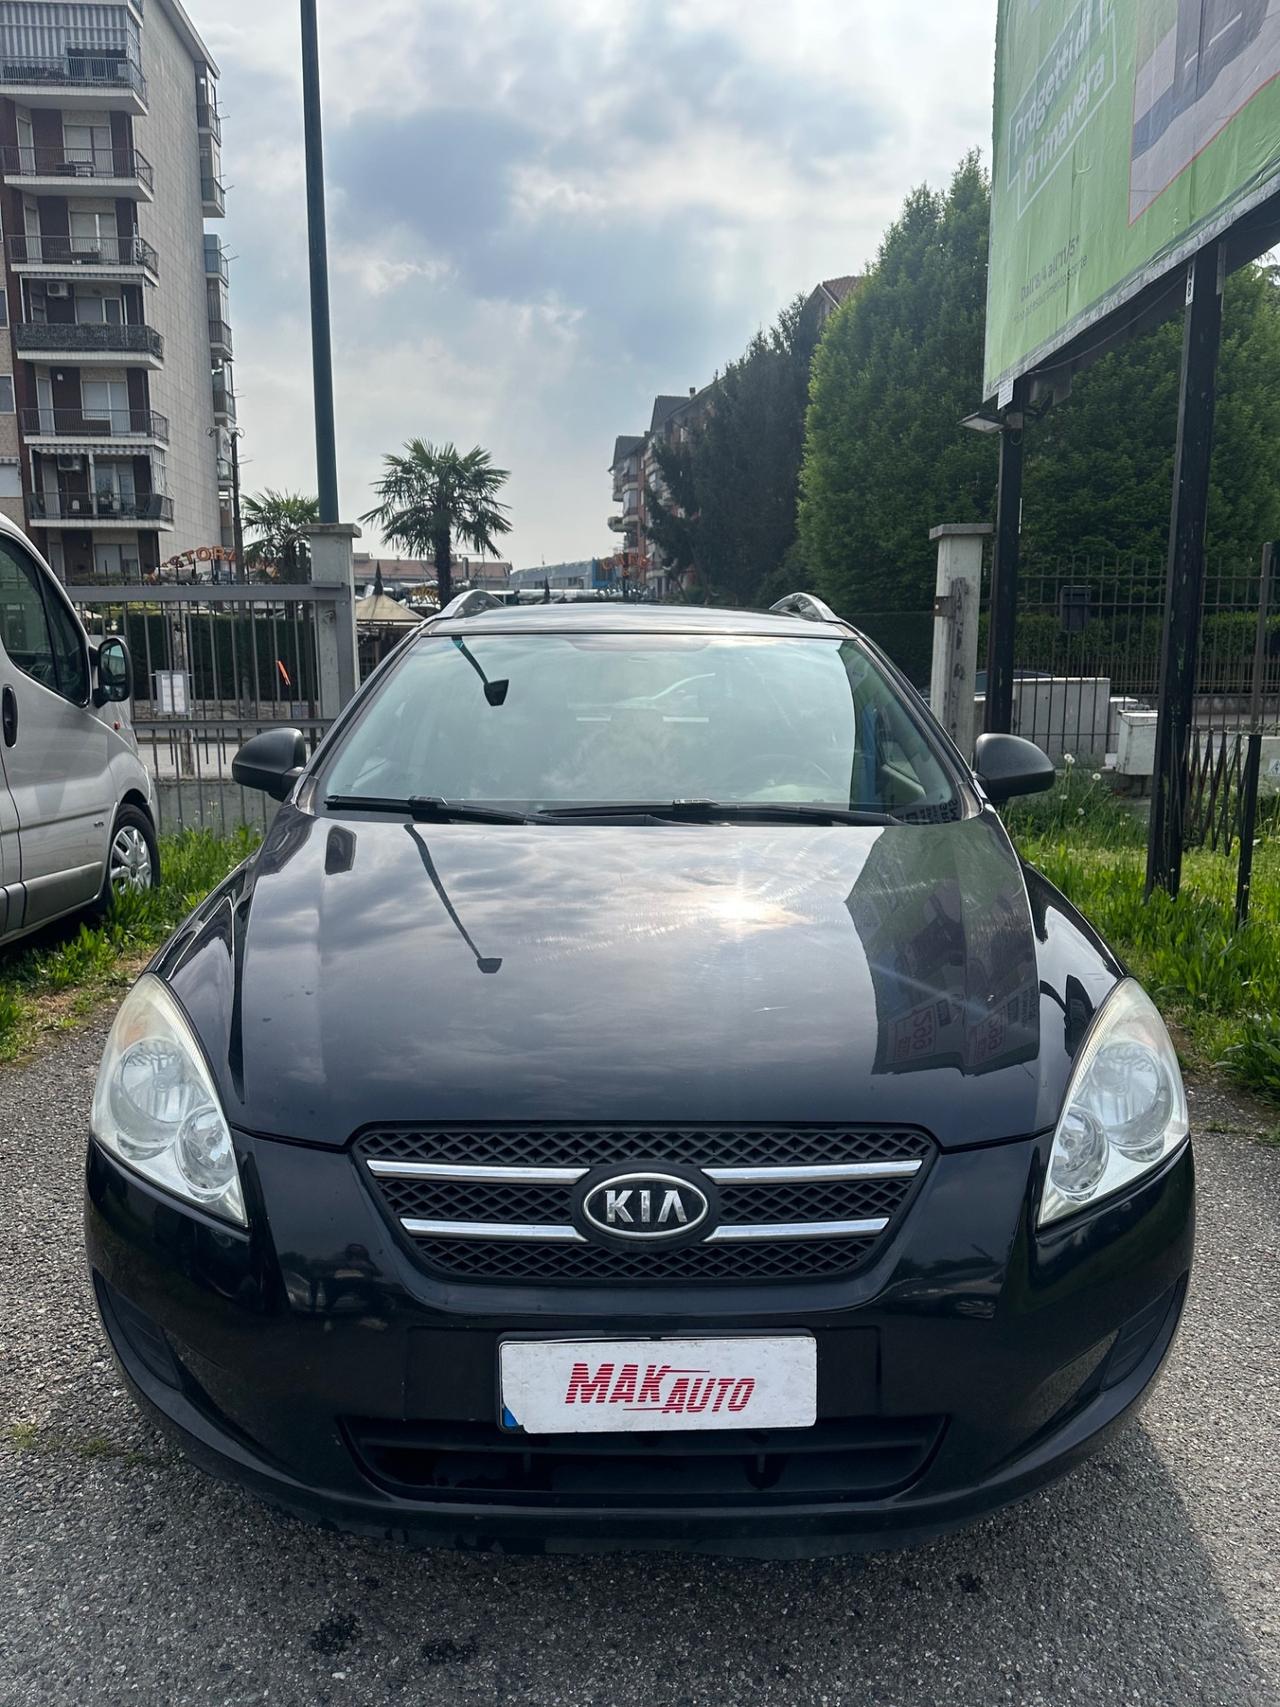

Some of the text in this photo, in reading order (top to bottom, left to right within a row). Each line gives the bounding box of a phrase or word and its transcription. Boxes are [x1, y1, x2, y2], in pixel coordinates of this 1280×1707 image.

[1015, 30, 1075, 155] Progetti
[1024, 54, 1105, 193] Primavera
[604, 1189, 688, 1223] KIA
[565, 1363, 756, 1414] MAK AUTO
